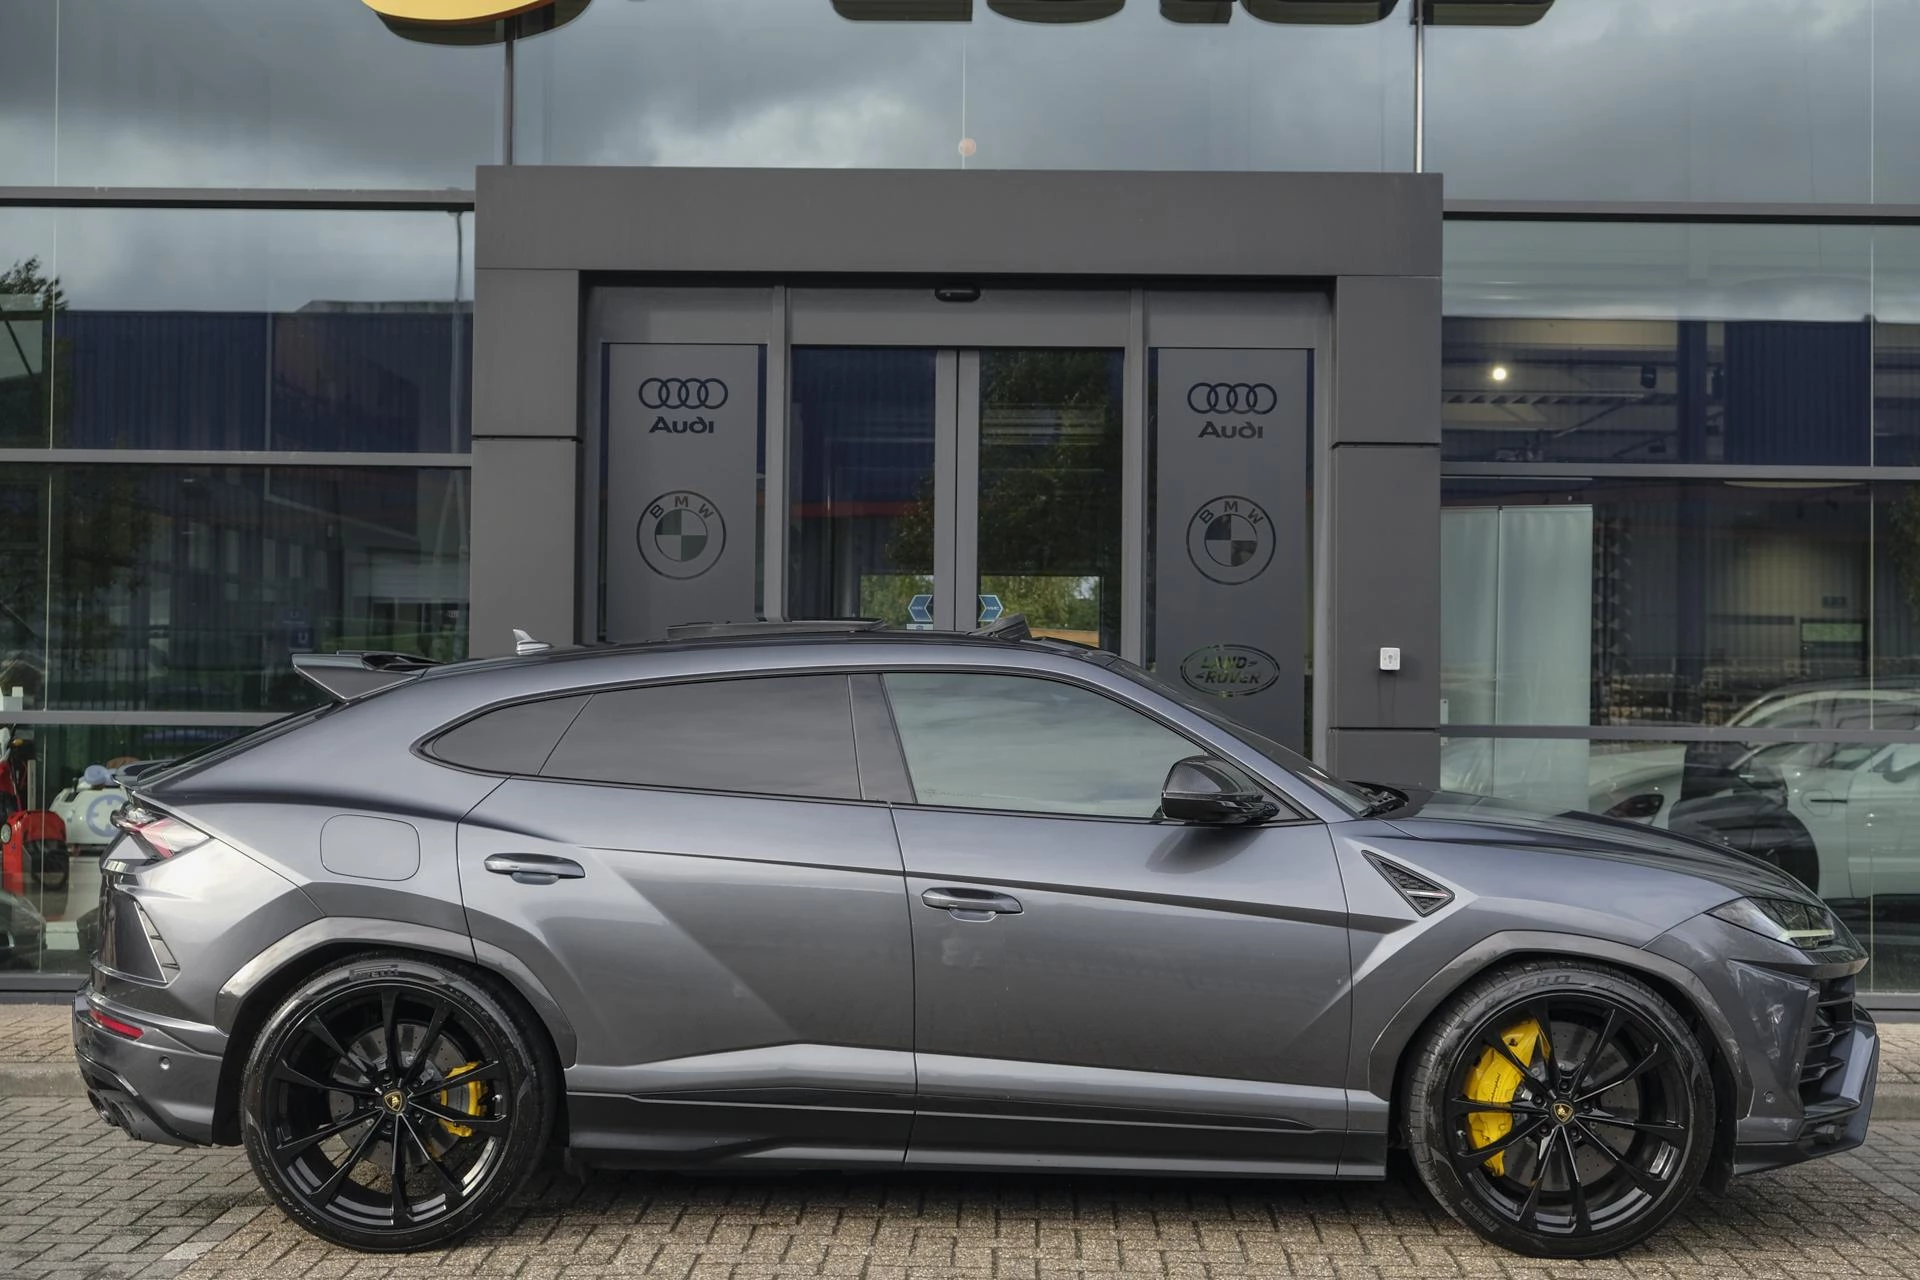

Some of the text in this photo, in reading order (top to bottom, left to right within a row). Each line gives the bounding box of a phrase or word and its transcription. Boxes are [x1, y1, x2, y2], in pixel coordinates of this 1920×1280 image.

[649, 416, 714, 433] Audi
[1198, 421, 1263, 439] Audi
[650, 496, 714, 519] BMW
[1199, 501, 1264, 524] BMW
[1201, 656, 1248, 669] LAND
